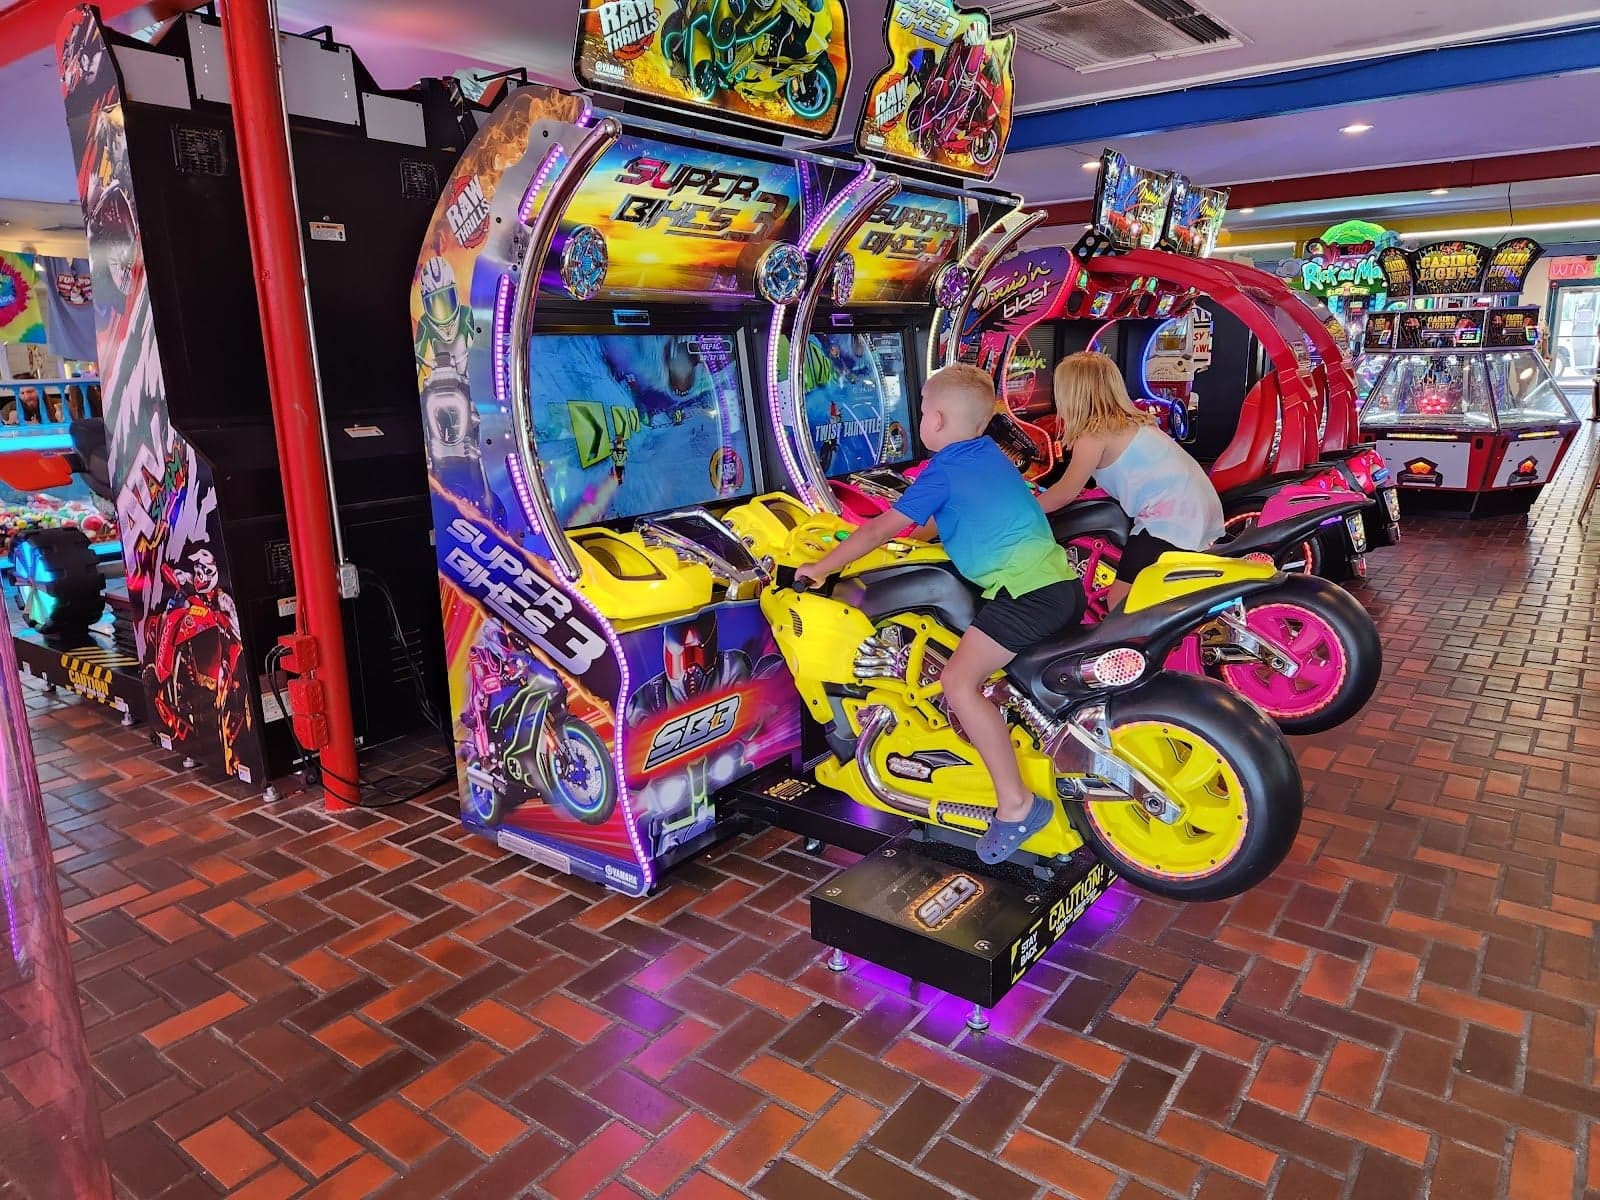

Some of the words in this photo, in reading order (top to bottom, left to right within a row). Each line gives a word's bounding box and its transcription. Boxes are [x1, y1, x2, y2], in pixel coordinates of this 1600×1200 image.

[604, 12, 660, 54] THRILLS
[875, 76, 909, 110] RAW
[615, 156, 760, 203] SUPER
[446, 174, 485, 232] RAW
[609, 193, 741, 232] BIKES
[867, 203, 947, 231] SUPER
[456, 199, 491, 247] THRILLS
[1419, 266, 1479, 281] LIGHTS
[1421, 254, 1478, 268] CASINO
[1488, 265, 1525, 278] LIGHTS
[1493, 252, 1531, 266] CASINO
[1003, 279, 1051, 319] blast
[815, 422, 842, 443] TWIST
[446, 518, 573, 620] SUPER
[444, 547, 556, 635] BIKES
[559, 617, 609, 675] 3
[68, 669, 109, 697] CAUTION
[645, 695, 740, 770] SB3
[1048, 863, 1105, 931] CAUTION!
[1020, 943, 1038, 968] BACK
[1021, 931, 1038, 955] STAY
